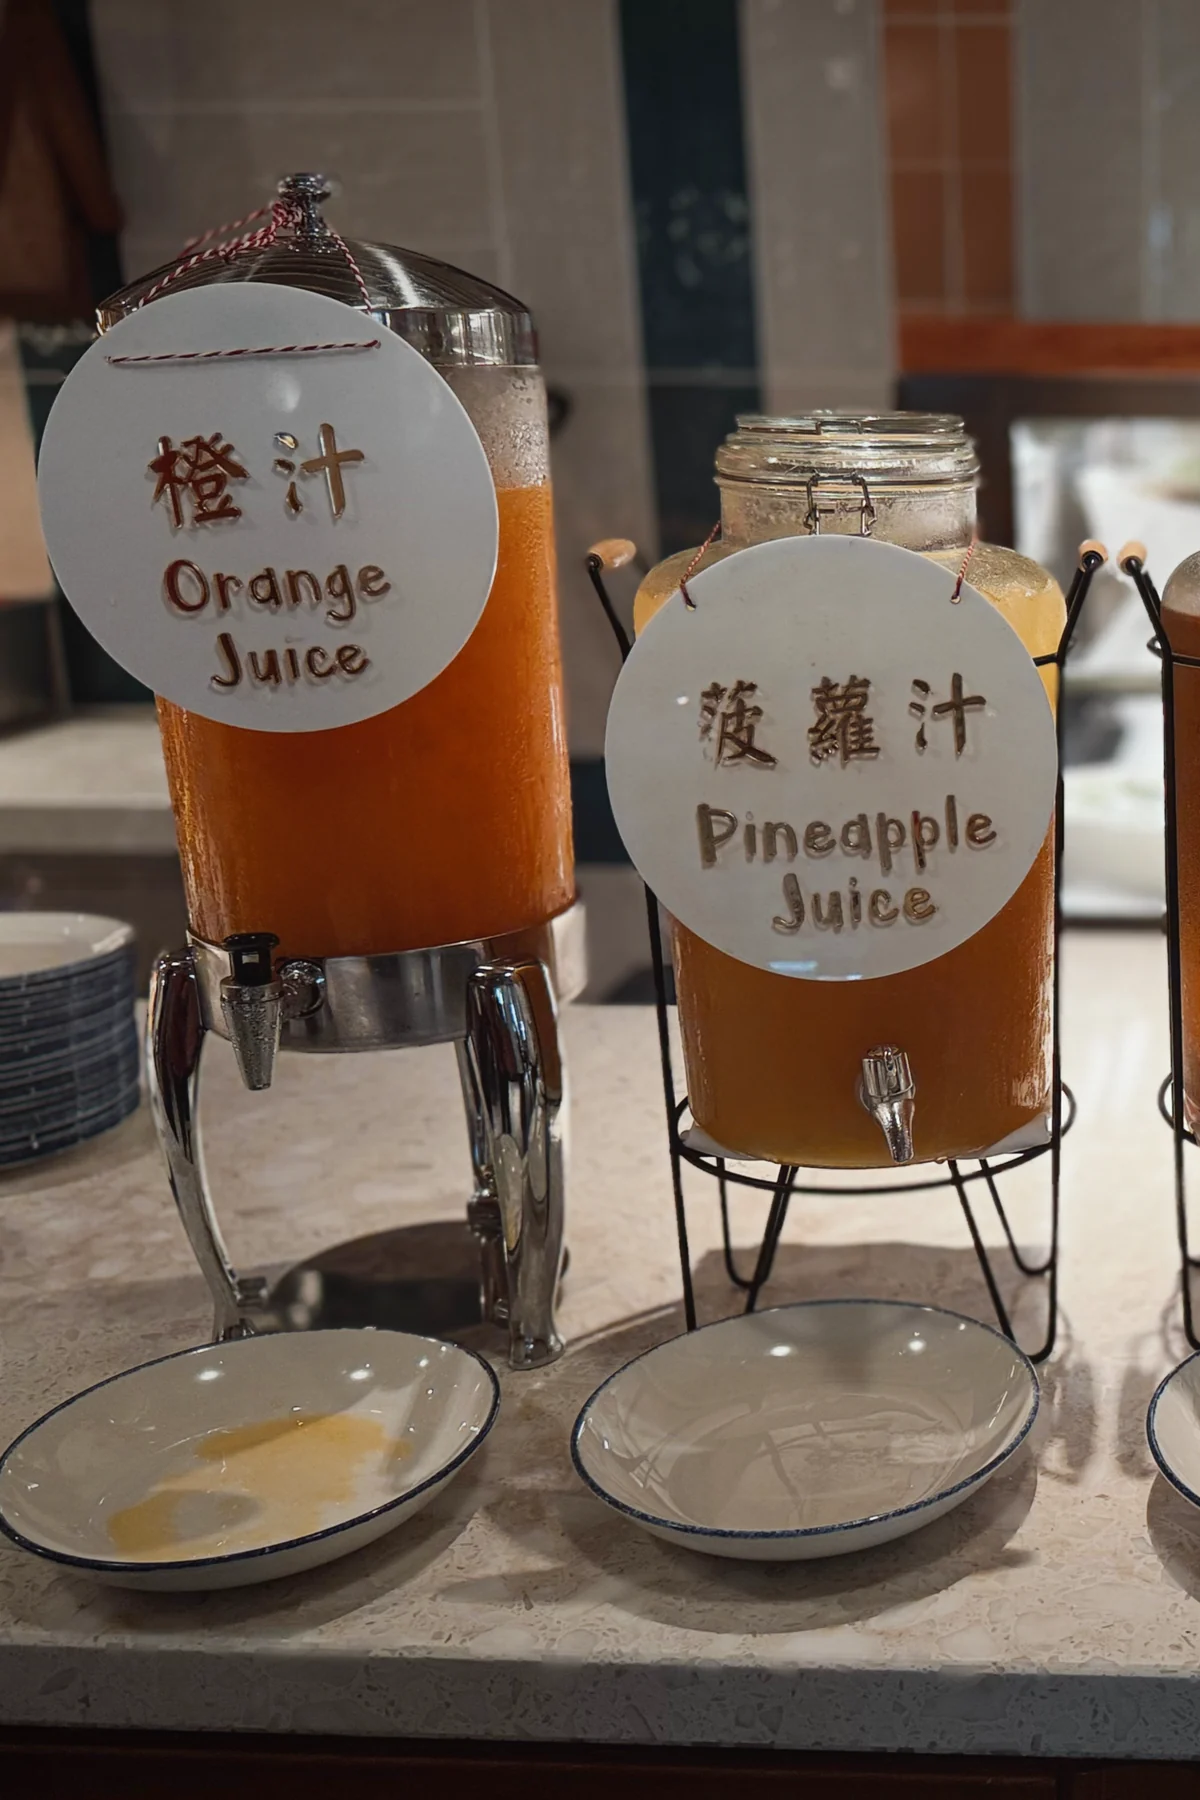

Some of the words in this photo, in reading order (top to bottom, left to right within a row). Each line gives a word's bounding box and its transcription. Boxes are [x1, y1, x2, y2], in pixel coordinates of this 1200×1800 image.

[148, 423, 365, 528] 橙汁
[163, 559, 391, 621] Orange
[210, 632, 371, 688] Juice
[699, 673, 987, 767] 菠蘿汁
[697, 795, 998, 870] Pineapple
[773, 873, 937, 932] Juice
